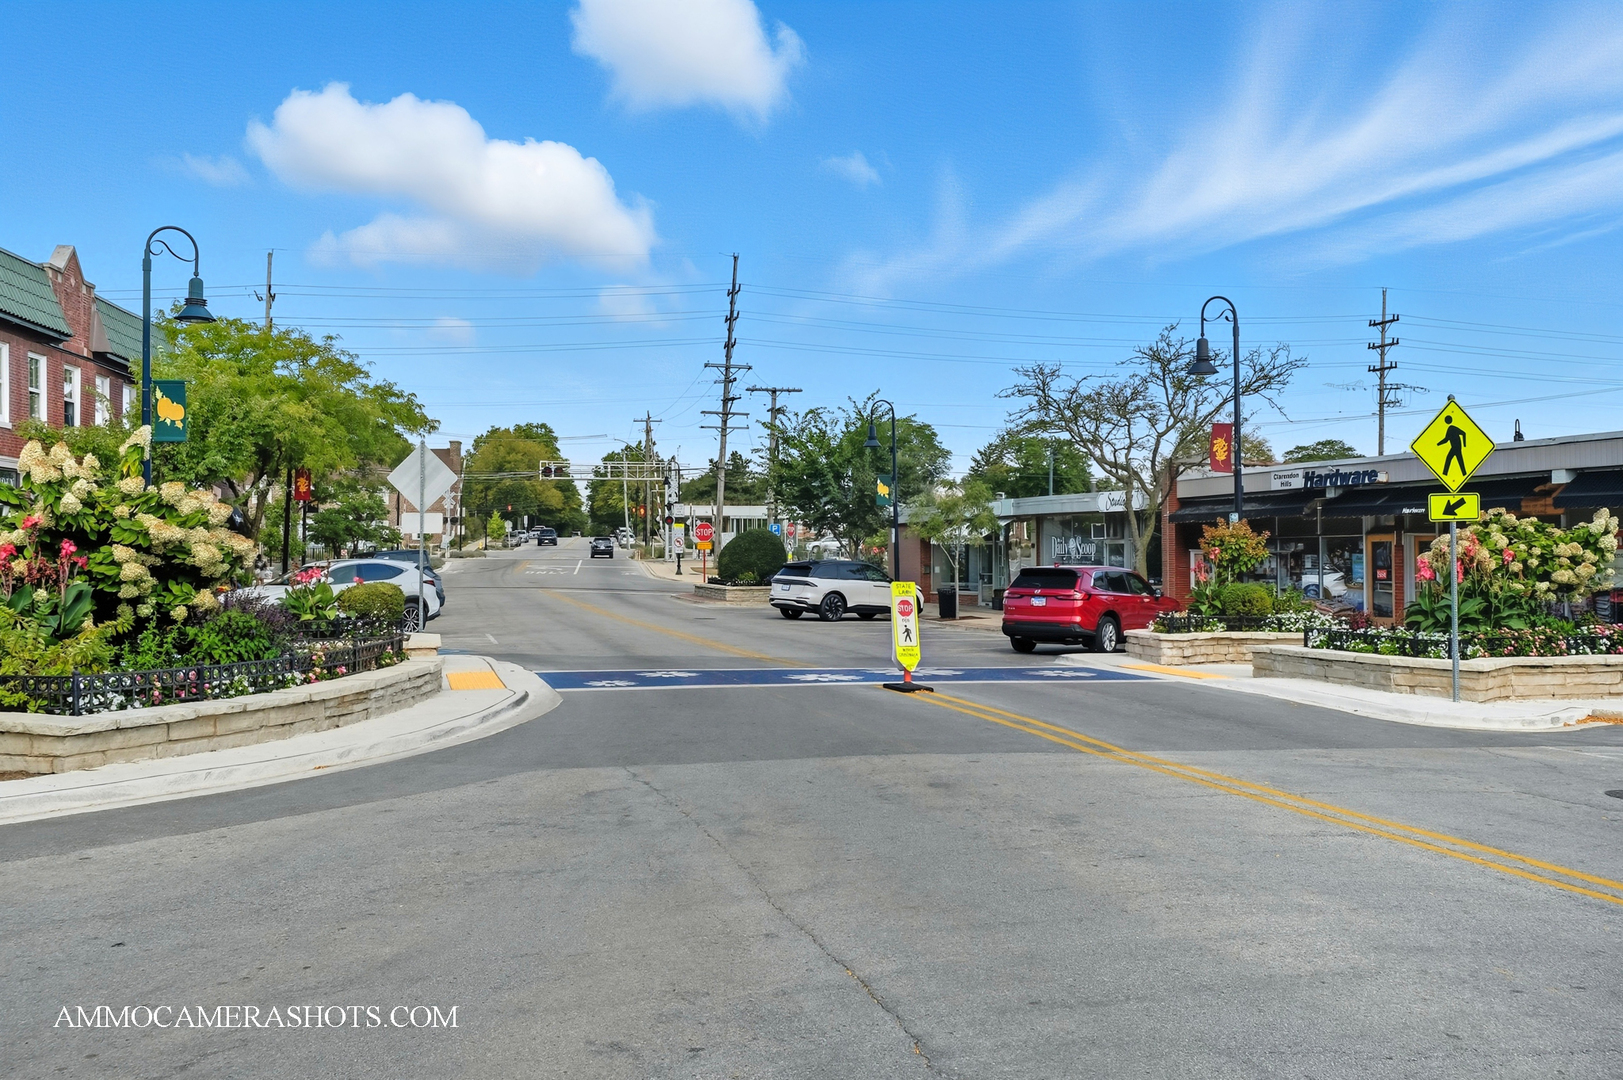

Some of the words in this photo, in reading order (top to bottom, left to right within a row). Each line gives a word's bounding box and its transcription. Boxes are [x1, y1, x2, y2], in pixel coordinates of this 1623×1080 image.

[1273, 472, 1300, 480] Clarendon
[1303, 469, 1378, 488] Hardware
[1051, 536, 1068, 560] Daily
[1076, 535, 1096, 561] Scoop
